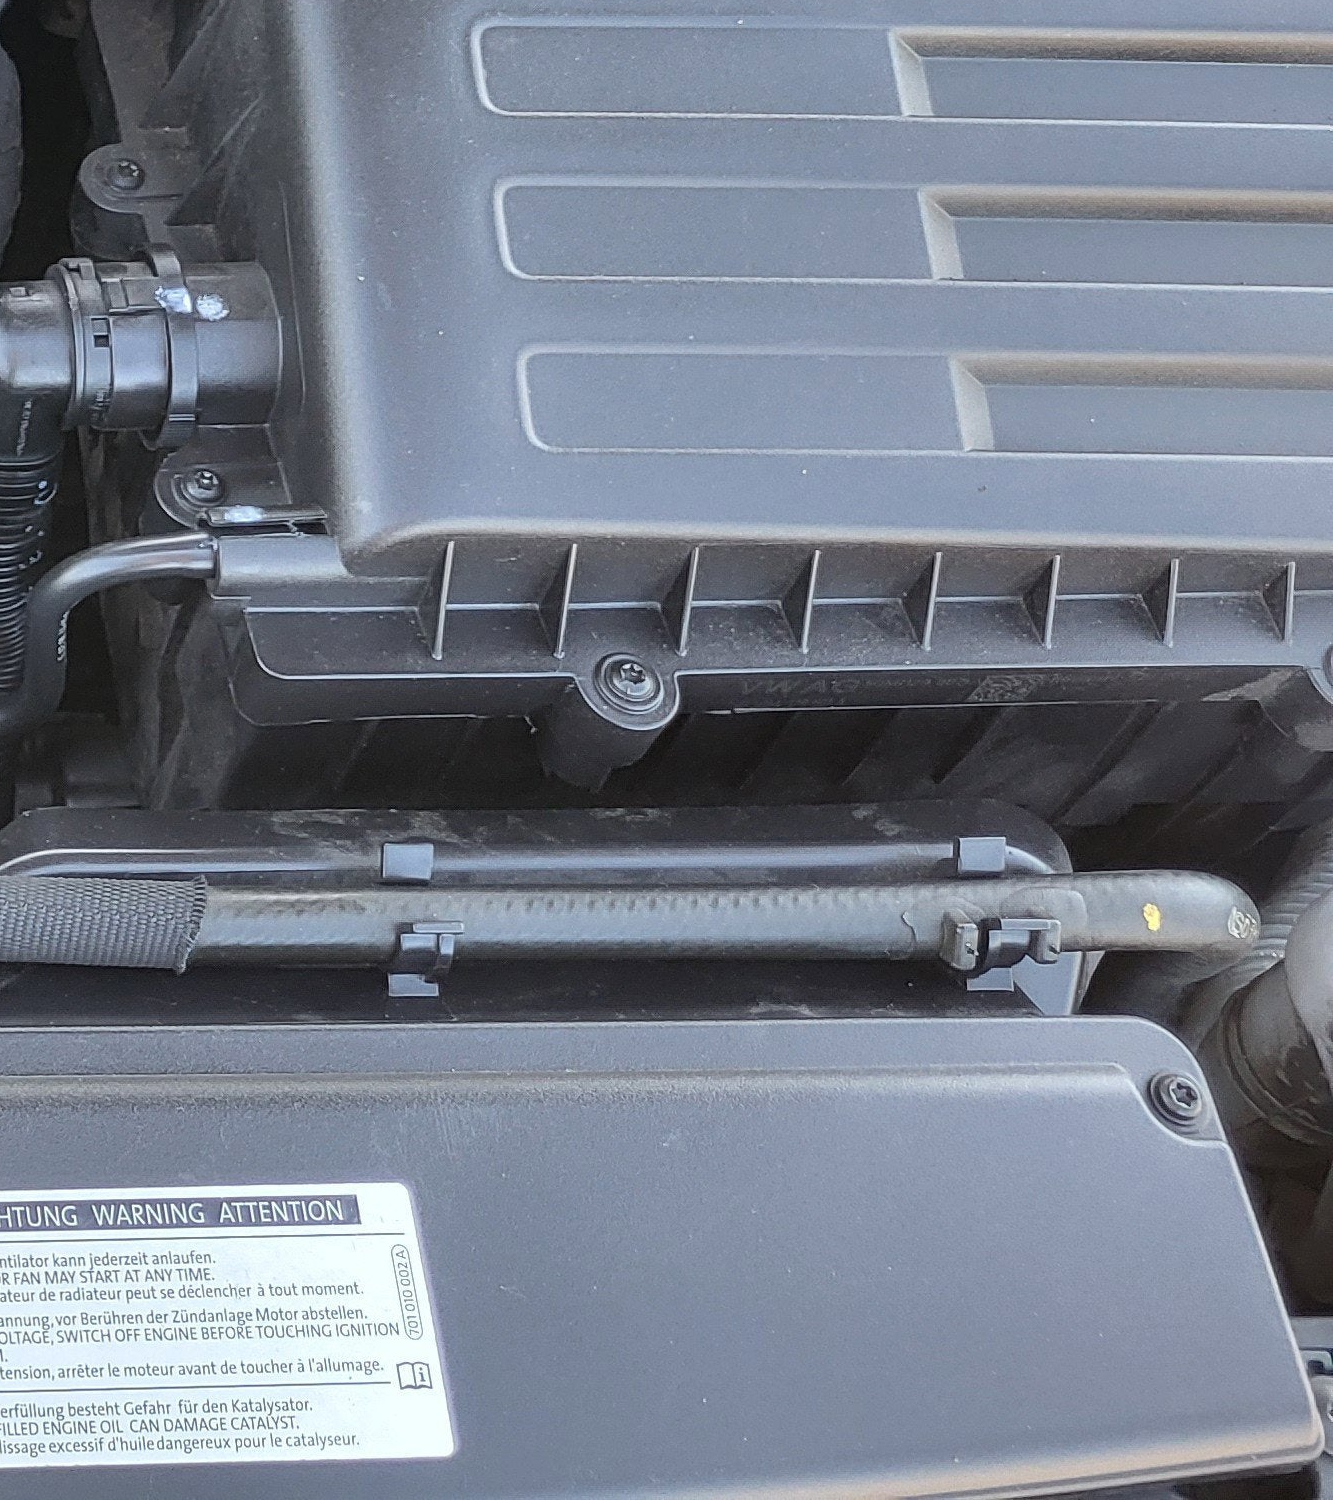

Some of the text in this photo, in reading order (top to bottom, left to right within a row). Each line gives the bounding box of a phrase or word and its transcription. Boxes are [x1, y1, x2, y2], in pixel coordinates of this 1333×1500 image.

[91, 1201, 204, 1226] WARNING
[219, 1199, 343, 1224] ATTENTION
[52, 1252, 85, 1268] kann
[89, 1251, 148, 1271] jederzeit
[151, 1249, 215, 1266] anlaufen.
[13, 1270, 40, 1285] FAN
[44, 1270, 75, 1285] MAY
[79, 1269, 119, 1284] START
[124, 1268, 140, 1283] AT
[144, 1268, 172, 1283] ANY
[176, 1267, 214, 1282] TIME.
[395, 1249, 420, 1336] 701 010 002 A
[56, 1328, 111, 1344] SWITCH
[114, 1327, 140, 1343] OFF
[143, 1326, 197, 1342] ENGINE
[200, 1325, 253, 1341] BEFORE
[255, 1323, 331, 1339] TOUCHING
[335, 1321, 399, 1337] IGNITION
[67, 1401, 120, 1417] besteht
[123, 1400, 170, 1416] Gefahr
[178, 1399, 197, 1415] für
[201, 1398, 228, 1414] den
[231, 1396, 312, 1418] Katalysator.
[42, 1421, 96, 1436] ENGINE
[99, 1419, 123, 1435] OIL
[129, 1418, 159, 1434] CAN
[163, 1417, 227, 1433] DAMAGE
[230, 1415, 299, 1432] CATALYST.
